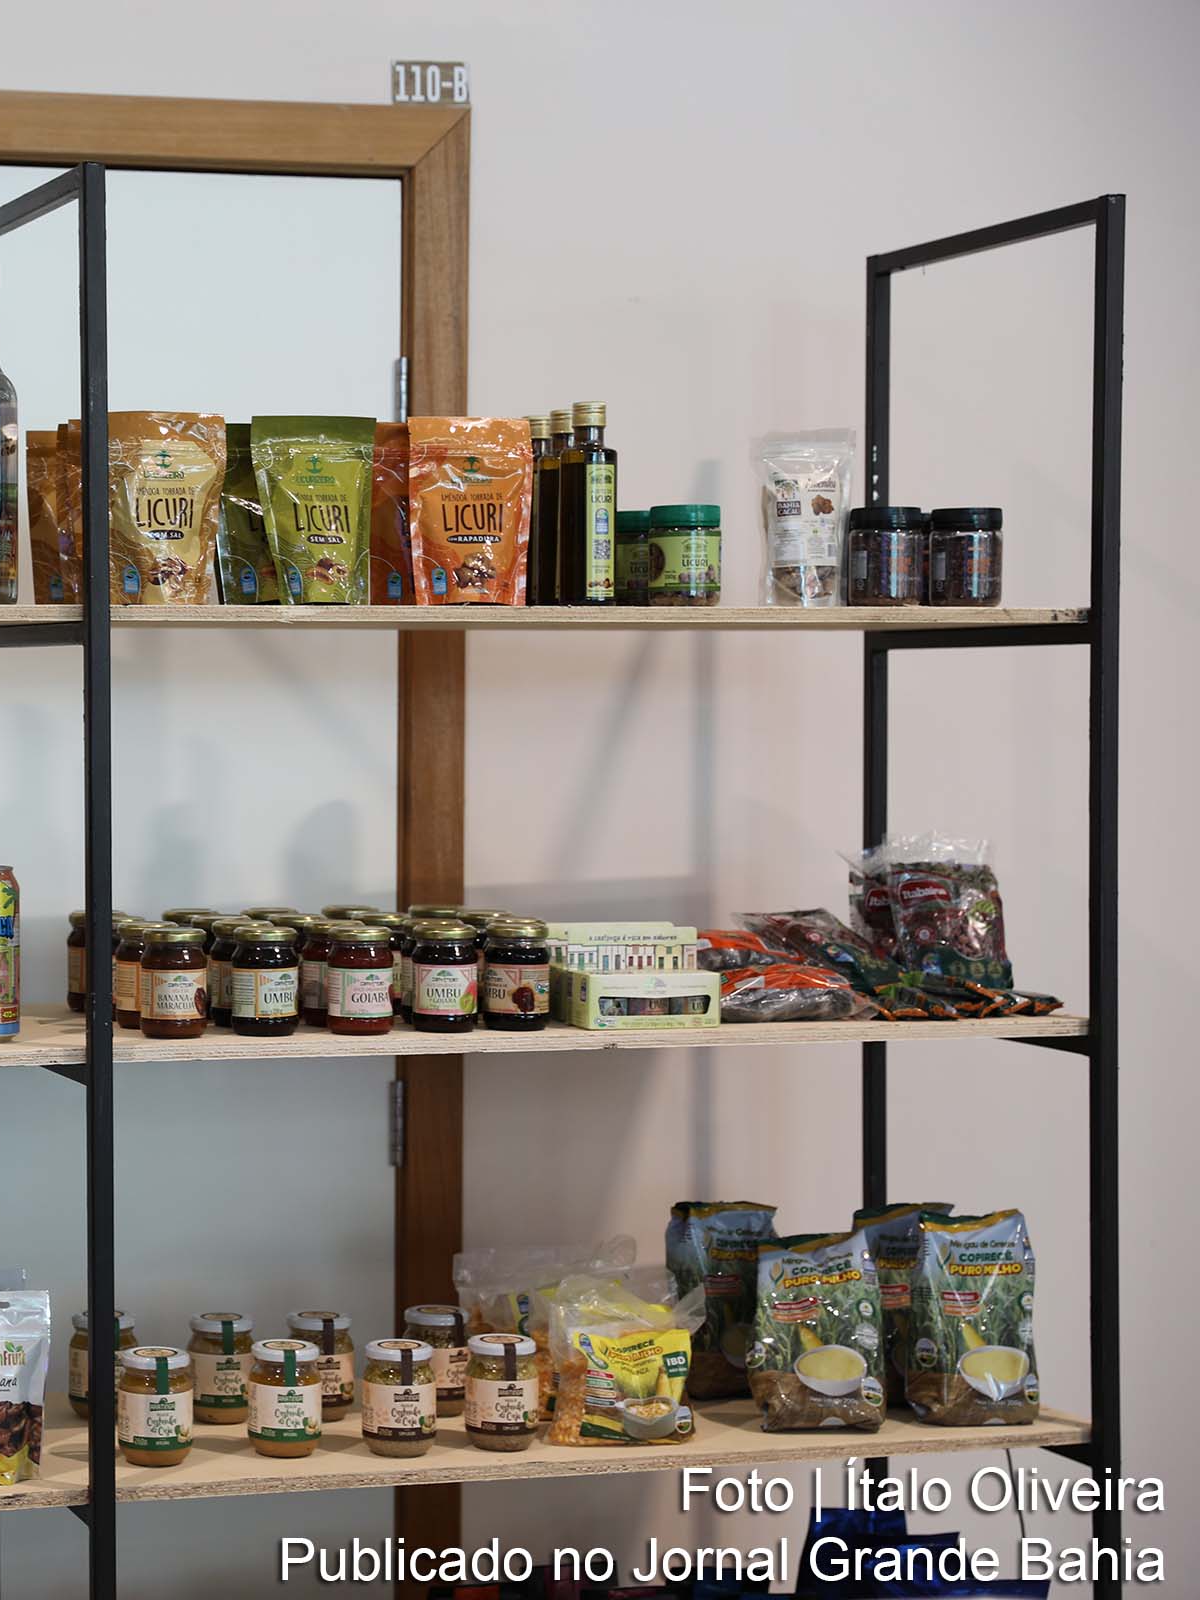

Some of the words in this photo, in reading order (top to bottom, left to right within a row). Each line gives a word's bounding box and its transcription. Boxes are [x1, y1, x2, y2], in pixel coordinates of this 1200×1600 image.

[395, 64, 467, 102] 110-B
[135, 497, 194, 529] LICURI
[293, 502, 351, 534] LICURI
[441, 502, 504, 533] LICURI
[681, 559, 709, 567] LICURI
[157, 994, 189, 1002] BANANA
[264, 991, 295, 1005] UMBU
[351, 991, 389, 1004] GOIABA
[426, 987, 461, 999] UMBU
[949, 1263, 980, 1277] PURO
[982, 1262, 1023, 1276] MILHO
[783, 1274, 820, 1290] PURO
[820, 1269, 862, 1285] MILHO
[666, 1355, 686, 1367] IBD
